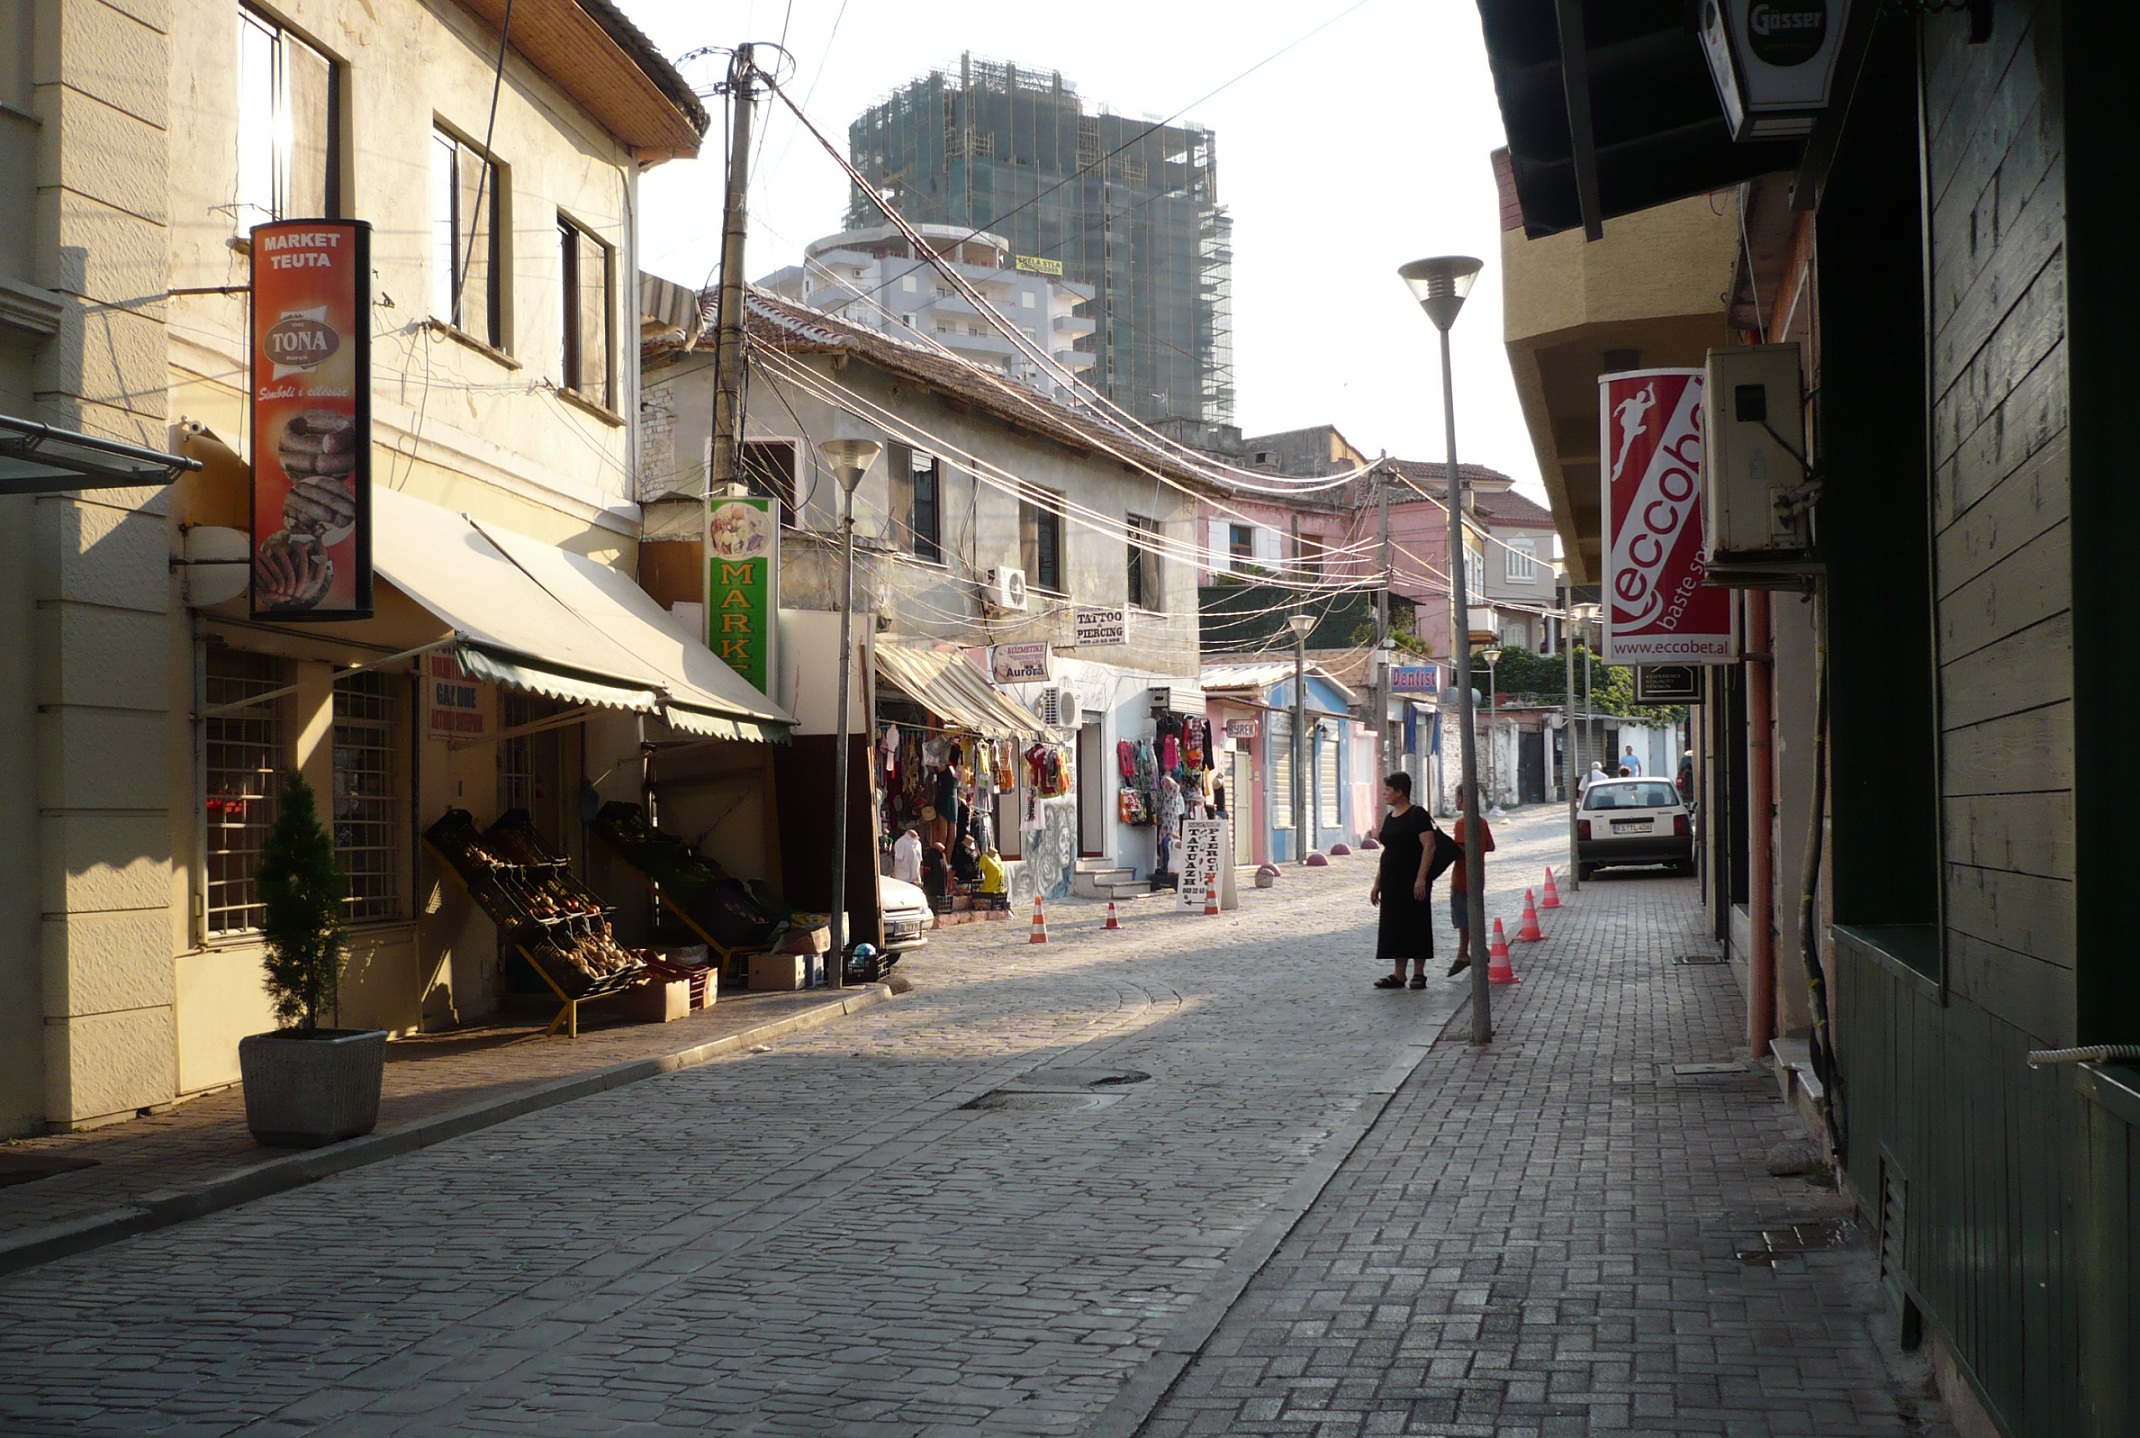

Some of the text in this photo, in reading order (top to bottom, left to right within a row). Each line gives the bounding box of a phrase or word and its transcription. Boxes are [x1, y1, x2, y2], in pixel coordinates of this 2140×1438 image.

[1751, 3, 1823, 36] Gösser
[264, 233, 341, 251] MARKET
[271, 253, 331, 269] TEUTA
[272, 330, 328, 353] TONA
[258, 385, 295, 401] Simboli
[1656, 576, 1697, 631] baste
[720, 562, 753, 670] MARK
[1077, 611, 1123, 625] TATTOO
[1076, 626, 1124, 640] PIERCING
[1614, 640, 1728, 655] www.eccobet.al
[1393, 668, 1437, 687] Dentist
[1228, 724, 1255, 736] BYREK
